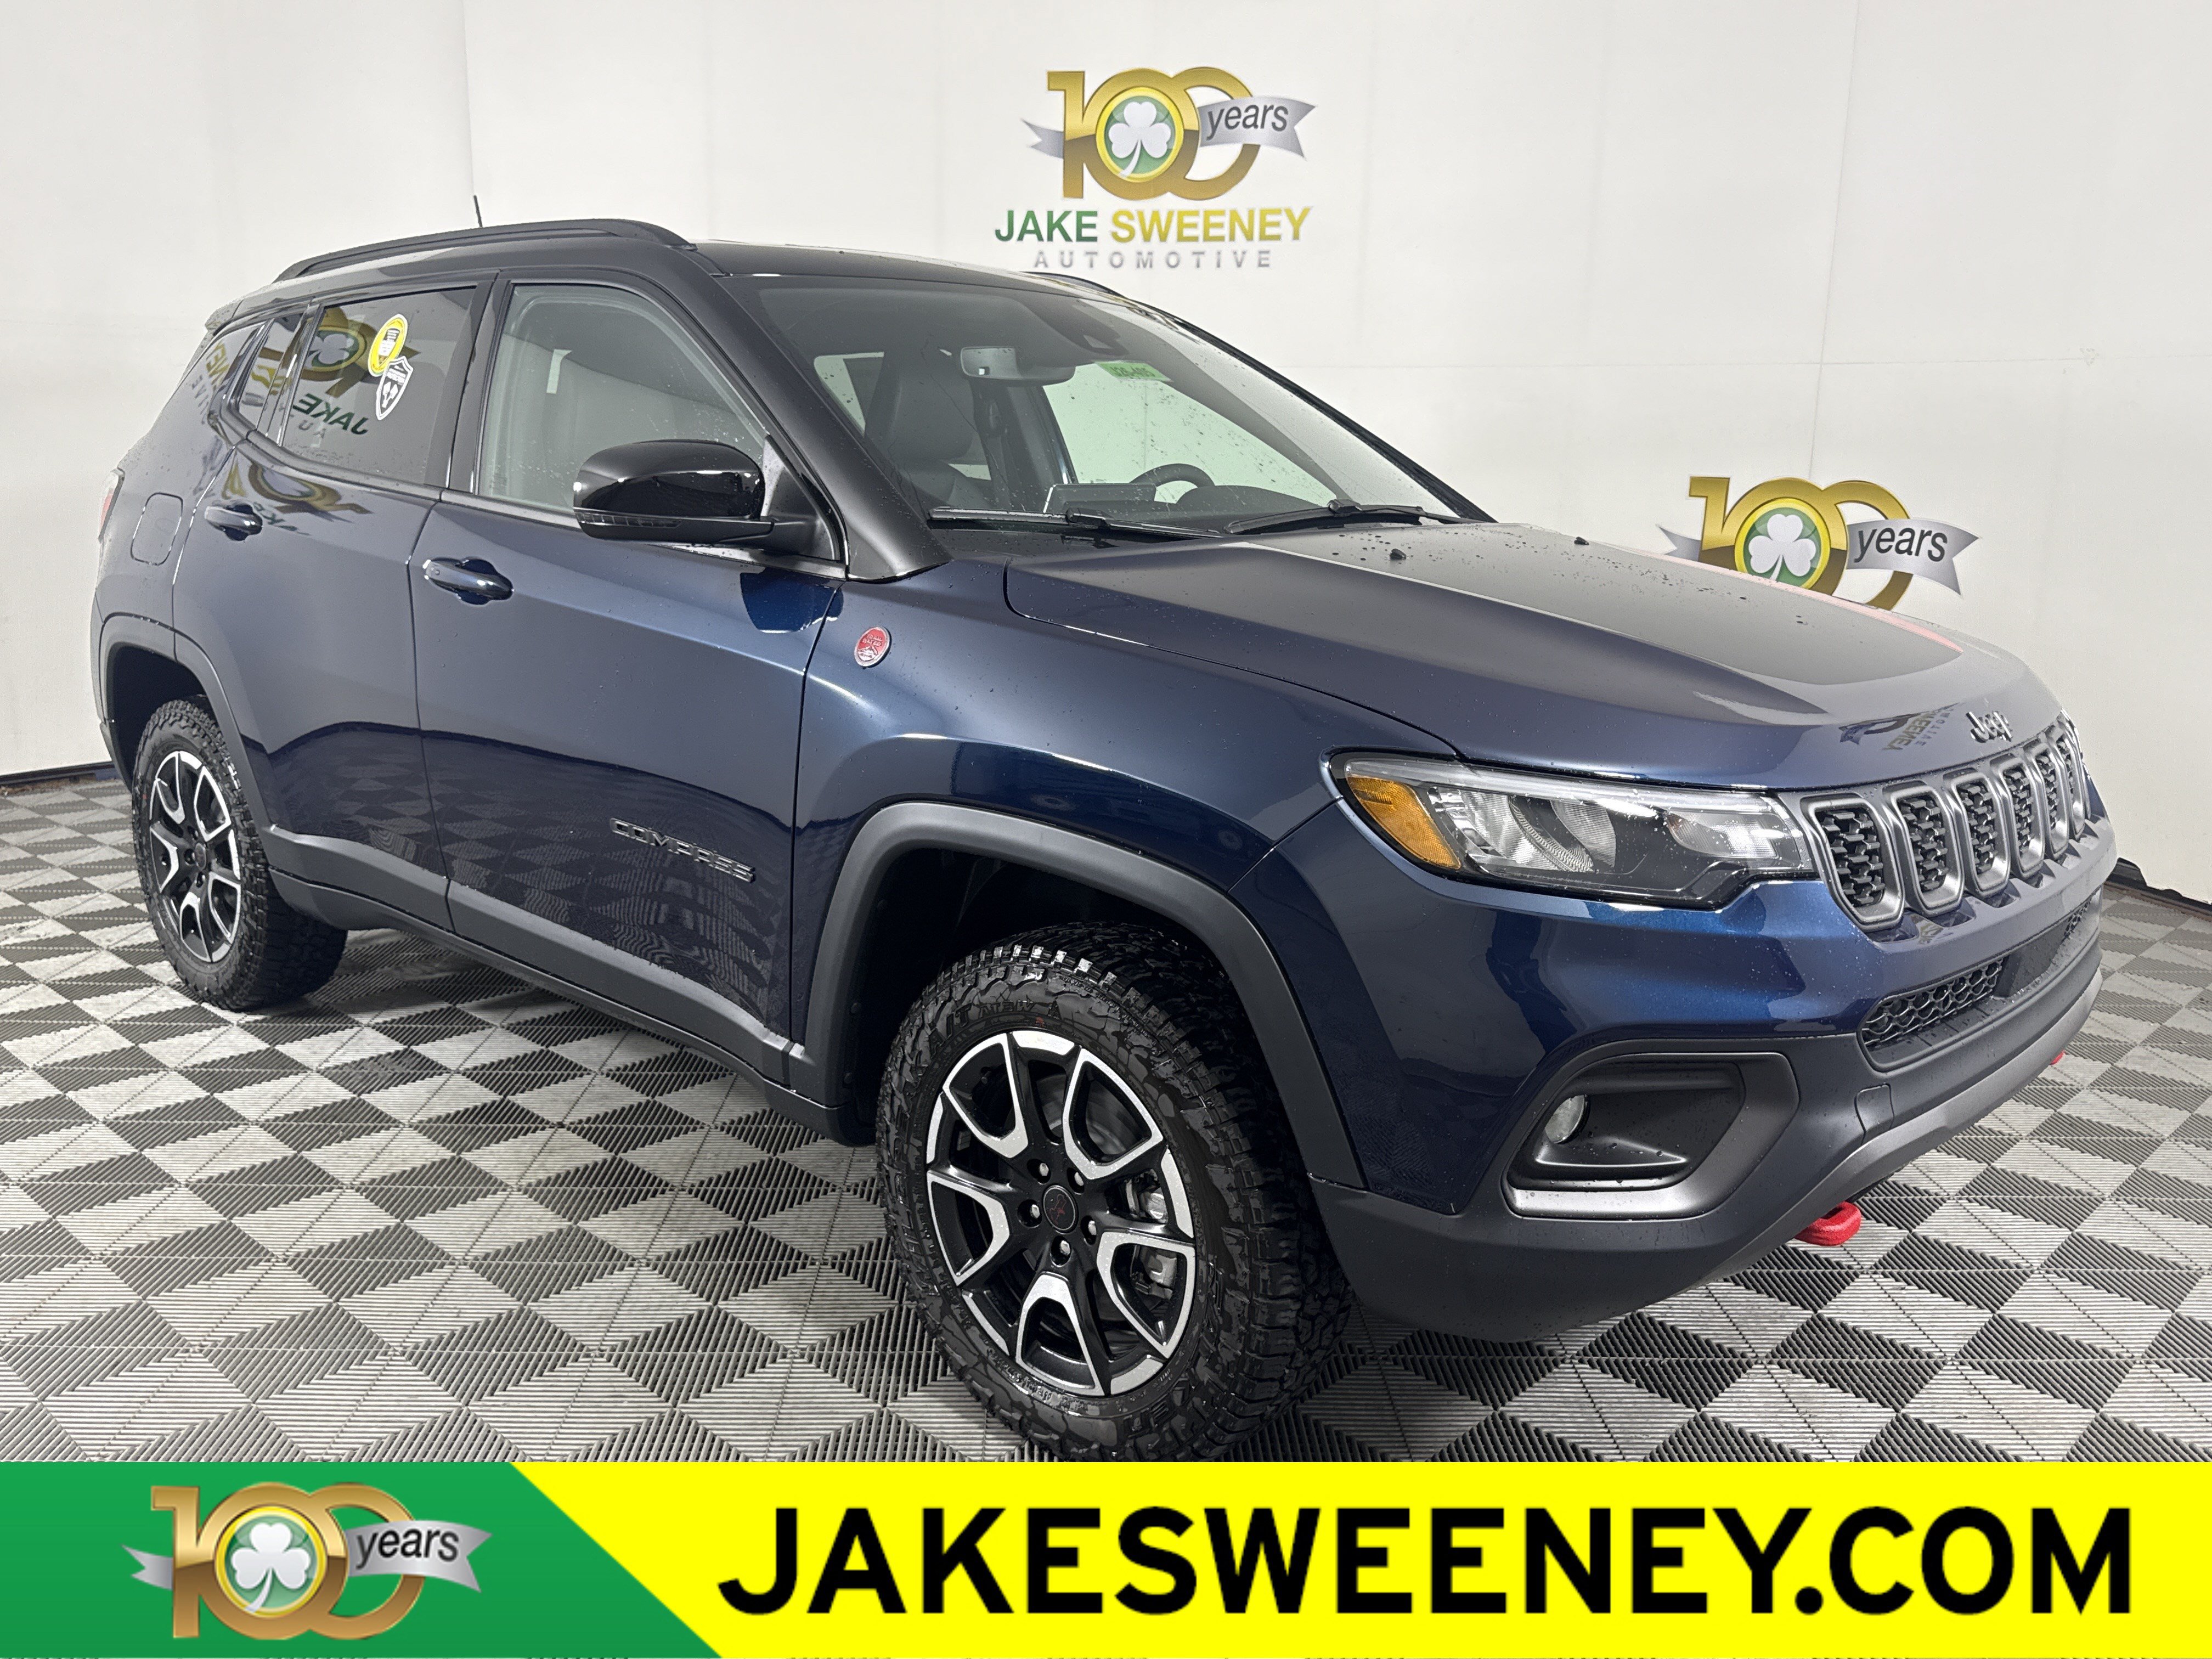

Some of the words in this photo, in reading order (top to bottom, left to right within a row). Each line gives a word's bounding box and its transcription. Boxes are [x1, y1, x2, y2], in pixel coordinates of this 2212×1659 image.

[1206, 103, 1289, 140] years
[995, 210, 1098, 243] JAKE
[1111, 207, 1312, 244] SWEENEY
[1034, 250, 1271, 269] AUTOMOTIVE
[1854, 525, 1948, 563] years
[1966, 711, 2012, 743] Jeep
[610, 818, 755, 883] COMPASS
